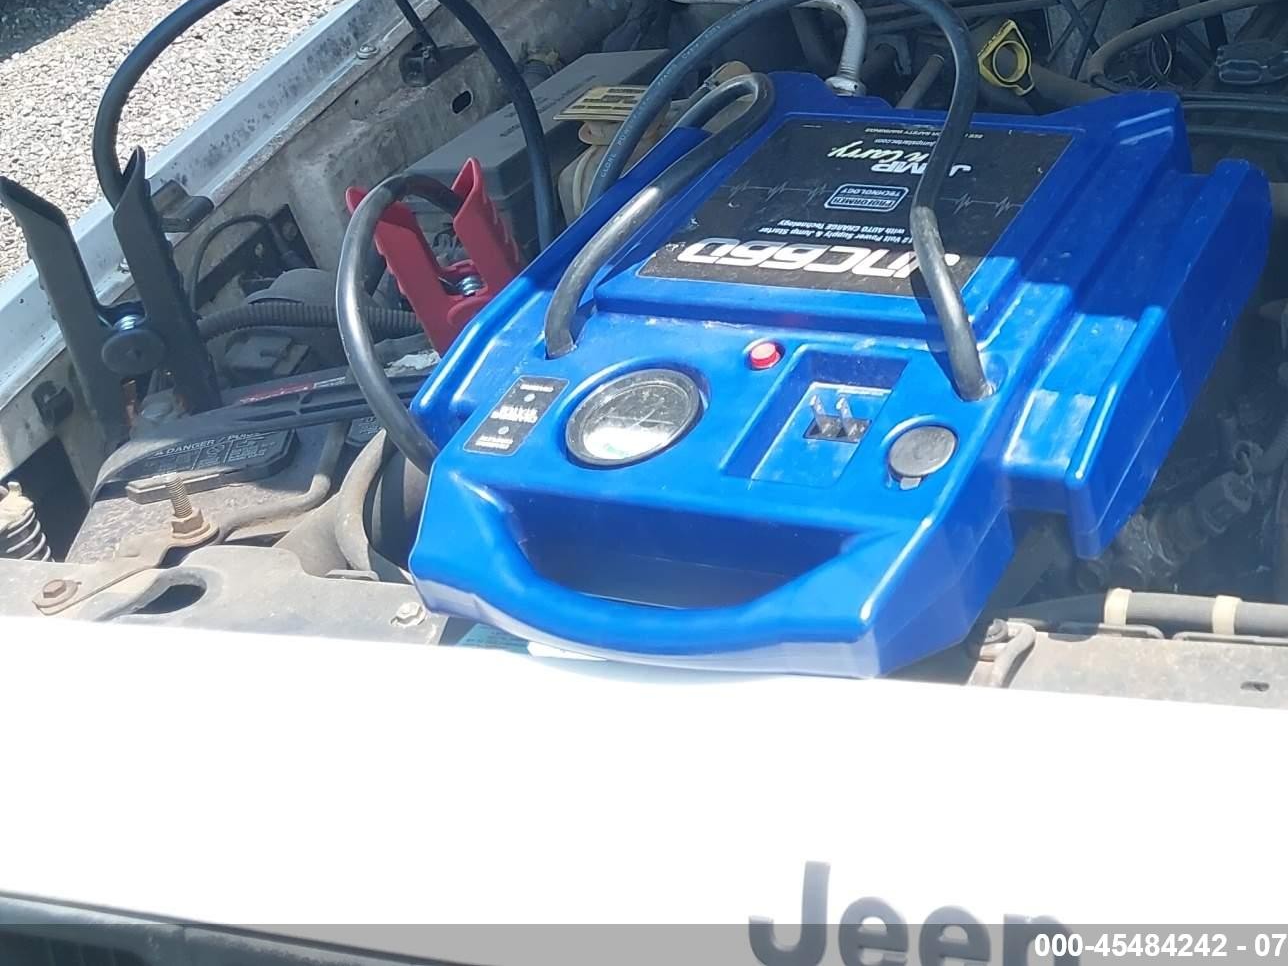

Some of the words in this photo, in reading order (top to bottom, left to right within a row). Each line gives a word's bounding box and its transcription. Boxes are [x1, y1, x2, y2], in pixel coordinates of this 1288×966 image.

[870, 160, 972, 177] JMP
[839, 186, 901, 198] TECHNOLOGY
[830, 196, 896, 208] PROFORMER
[776, 219, 825, 231] Technology
[825, 223, 860, 233] CHARGE
[861, 225, 885, 233] AUTO
[884, 226, 905, 234] with
[757, 226, 788, 236] Starter
[791, 227, 815, 238] Jump
[823, 231, 853, 241] Supply
[854, 232, 882, 243] Power
[882, 234, 900, 244] Volt
[166, 439, 216, 453] DANGER
